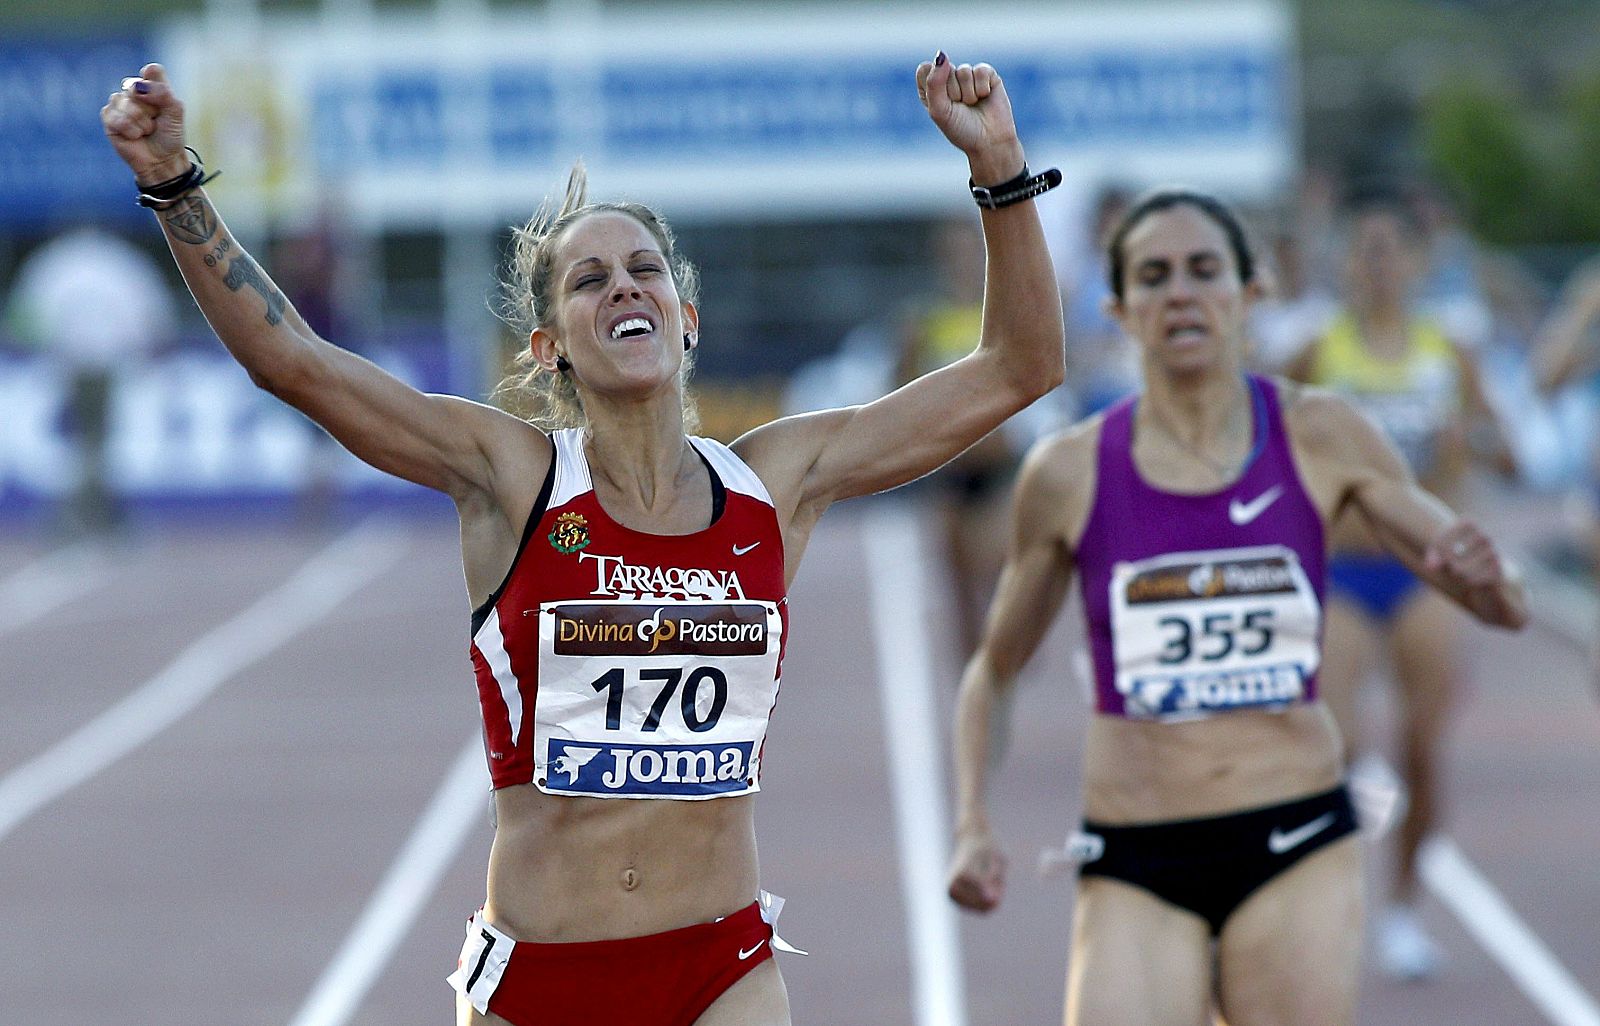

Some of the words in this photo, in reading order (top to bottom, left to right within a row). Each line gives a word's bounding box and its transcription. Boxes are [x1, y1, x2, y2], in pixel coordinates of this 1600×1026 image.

[560, 618, 634, 642] Divina
[679, 618, 763, 642] Pastora
[1158, 610, 1274, 665] 355
[591, 666, 728, 732] 170
